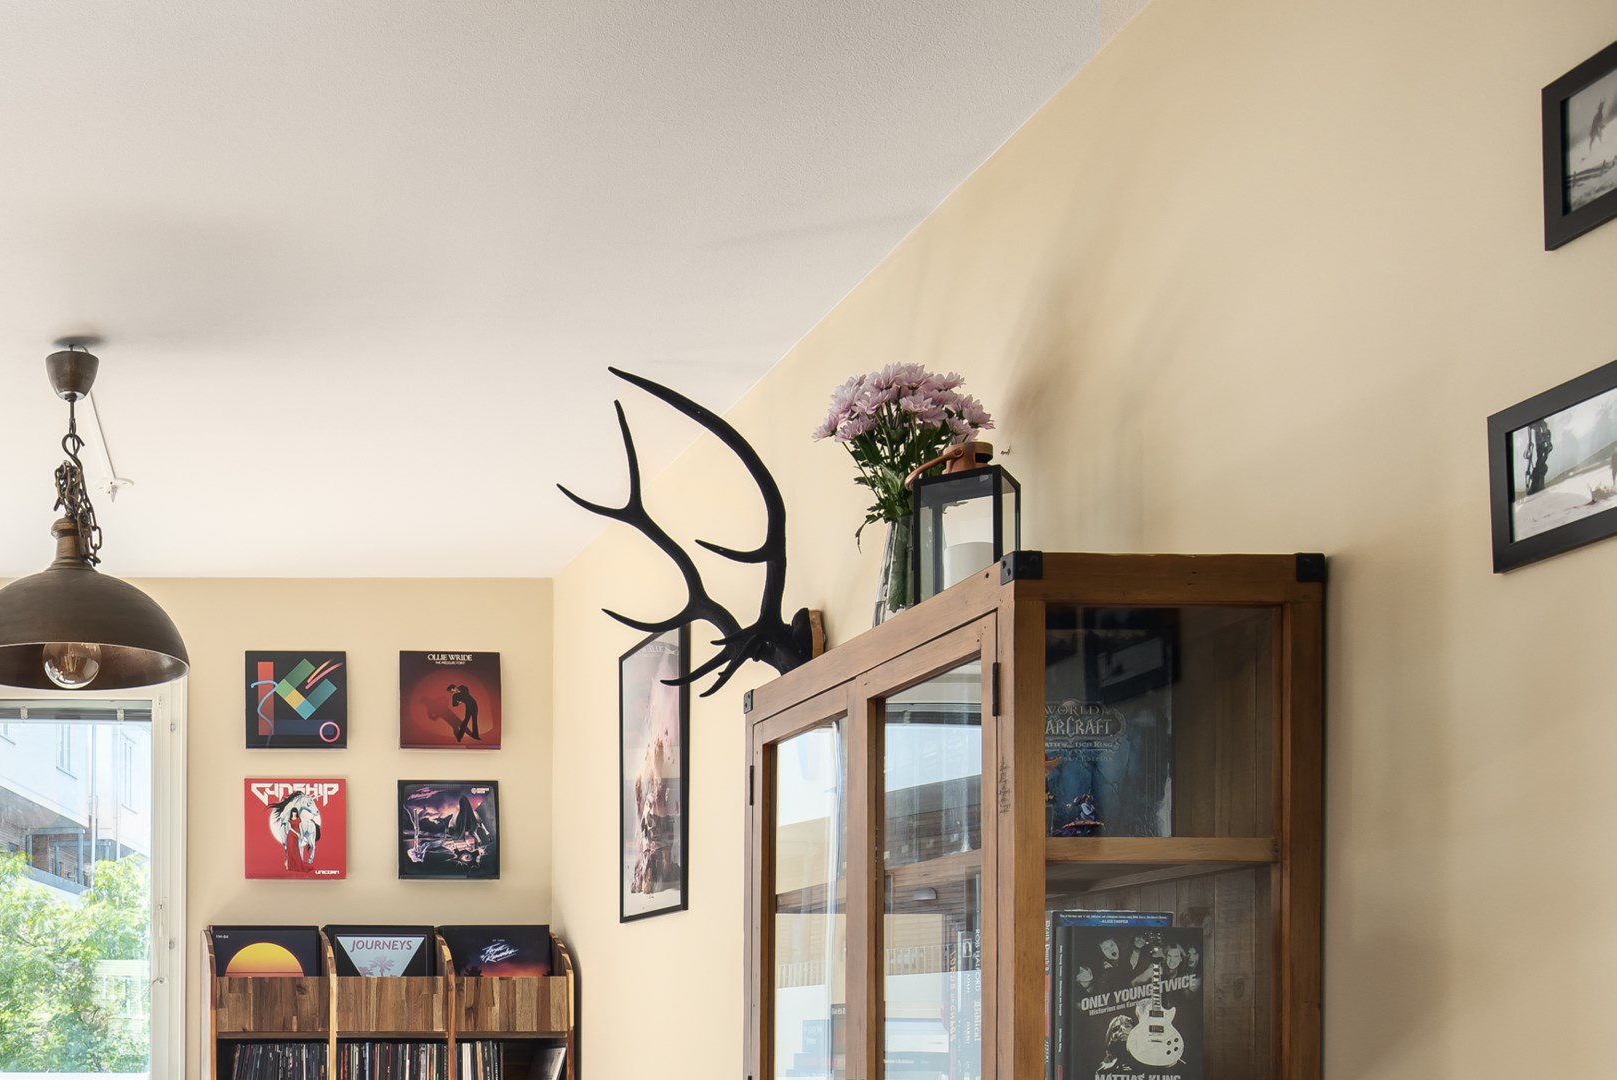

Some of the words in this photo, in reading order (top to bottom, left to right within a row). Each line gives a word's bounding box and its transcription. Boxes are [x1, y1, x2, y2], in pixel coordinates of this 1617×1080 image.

[427, 653, 448, 661] OLLIE
[448, 654, 473, 662] WRIDE
[1044, 705, 1100, 716] WORLD
[1044, 716, 1112, 738] ARCRAFT
[350, 940, 413, 953] JOURNEYS
[1081, 993, 1111, 1011] ONLY
[1113, 984, 1154, 1004] YOUNG
[1159, 974, 1197, 993] TWICE
[1089, 1004, 1116, 1016] Historien
[1116, 1003, 1126, 1011] om
